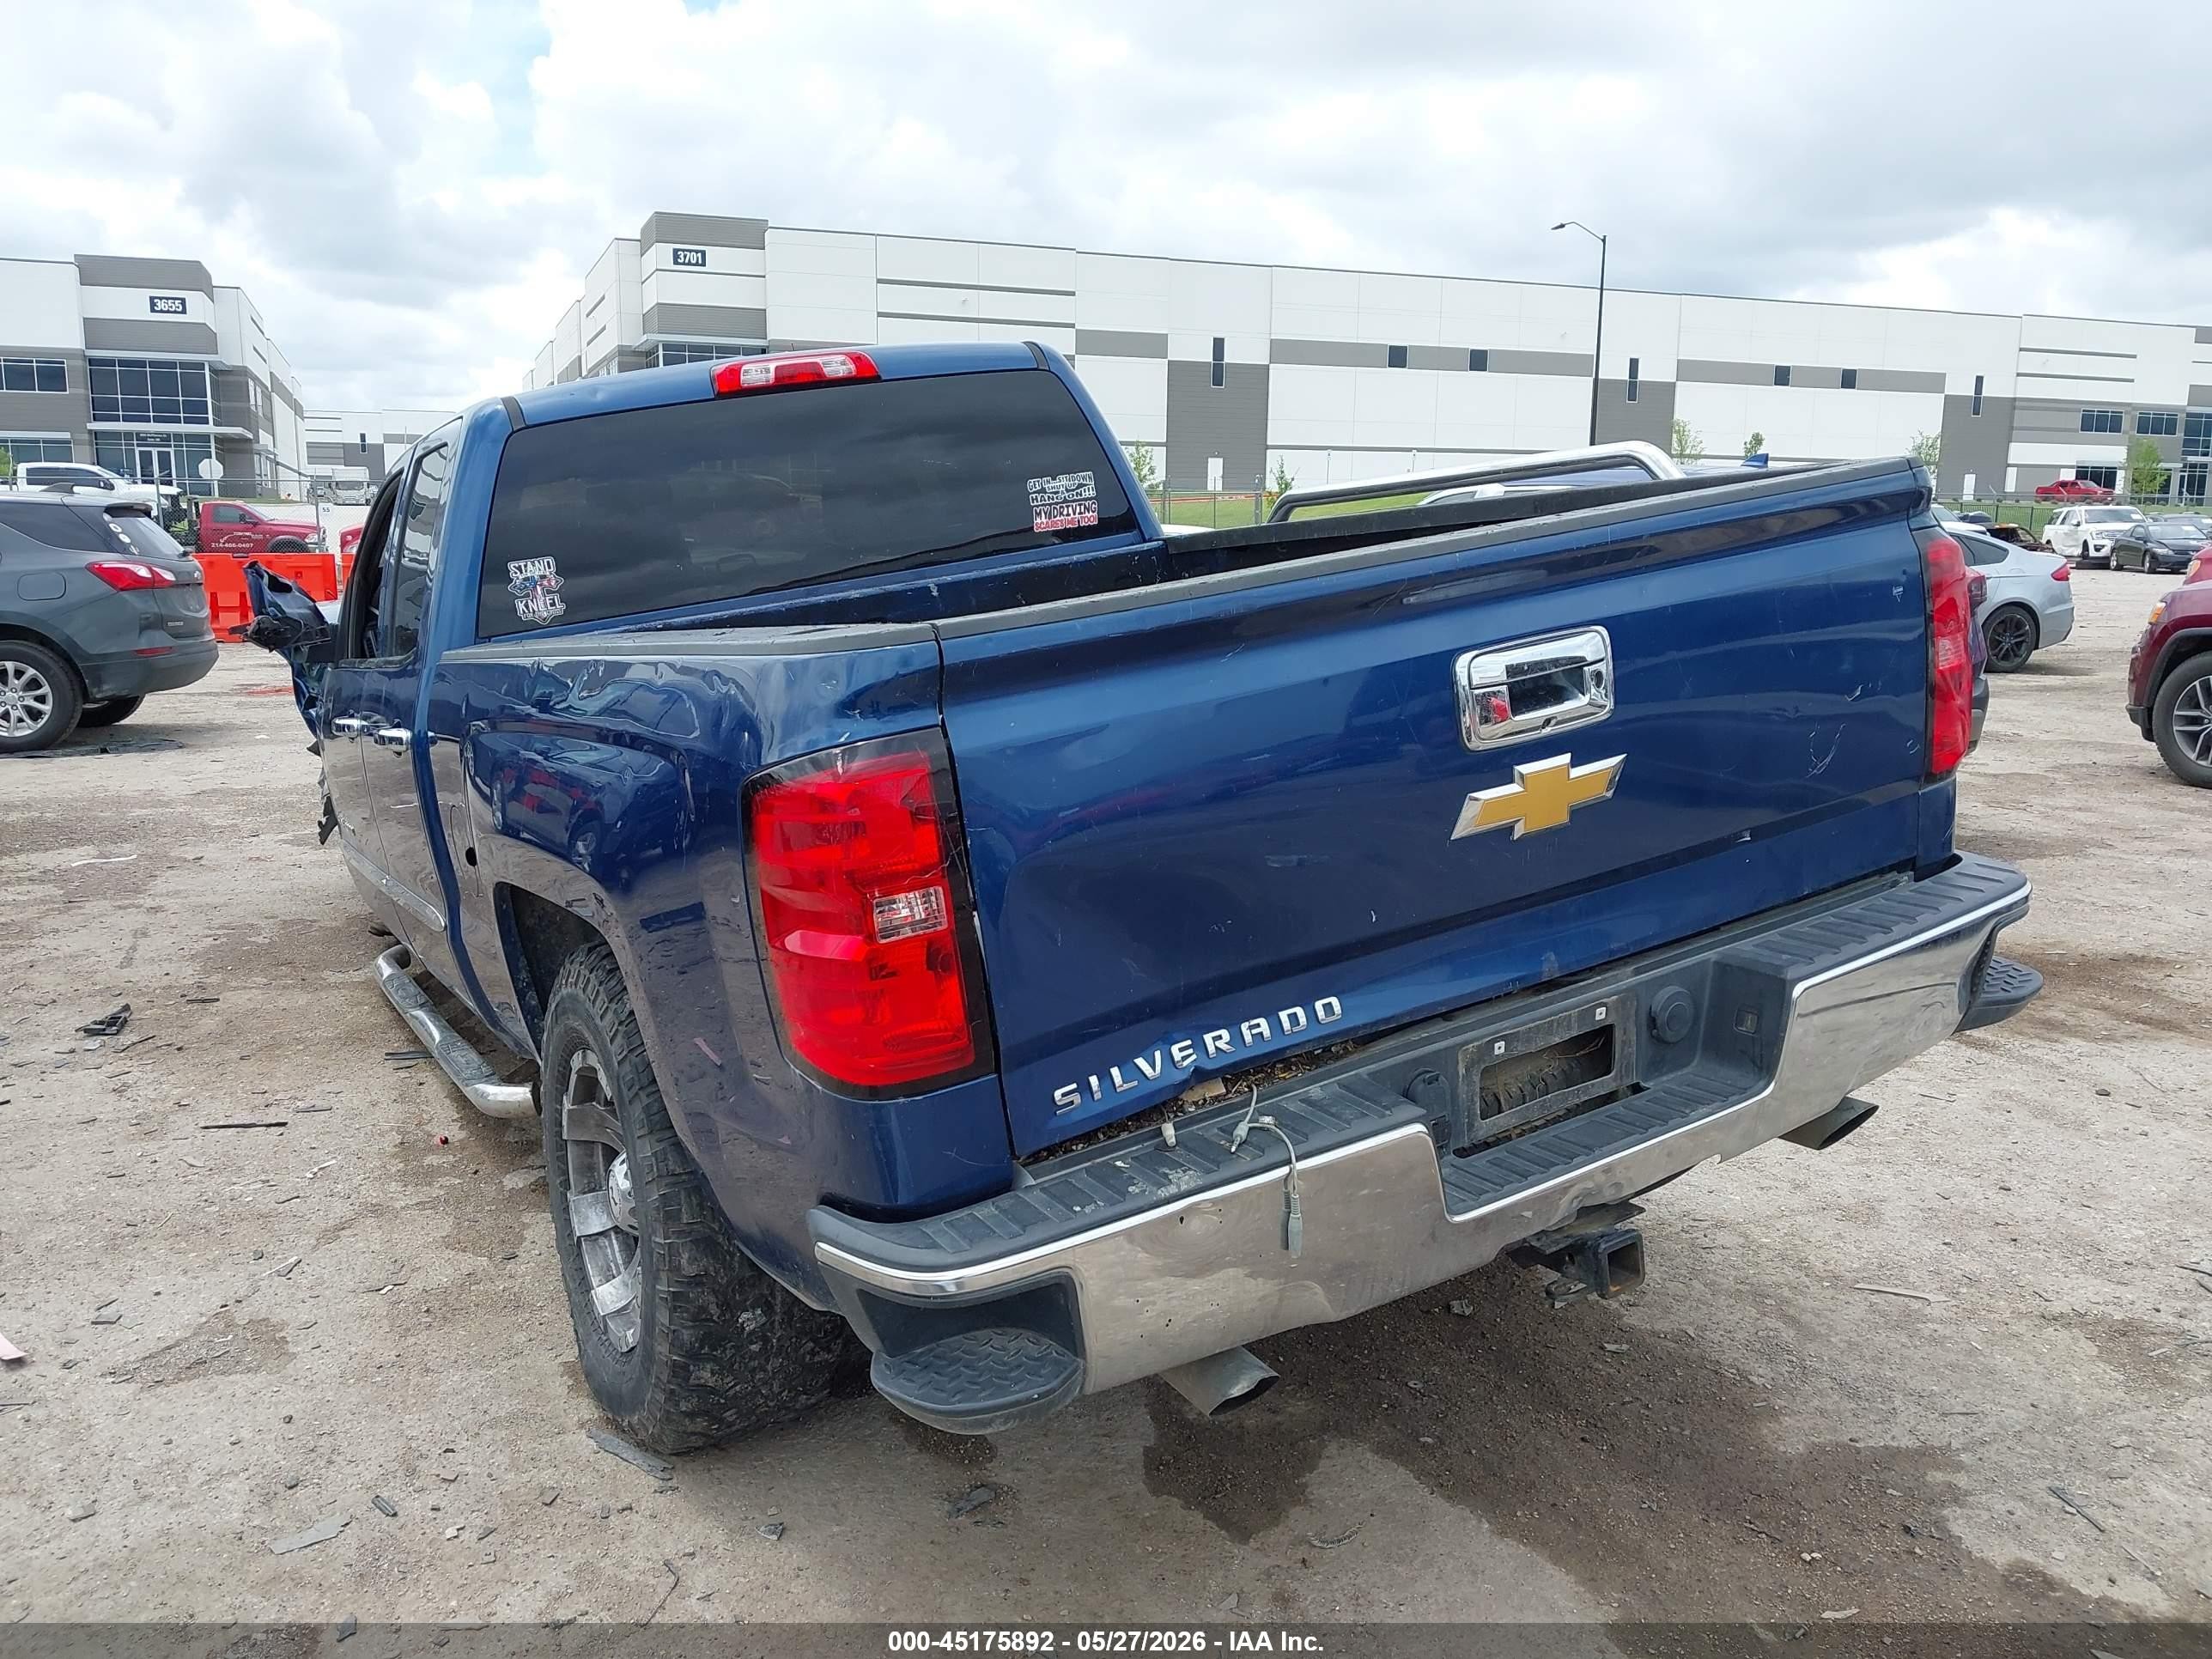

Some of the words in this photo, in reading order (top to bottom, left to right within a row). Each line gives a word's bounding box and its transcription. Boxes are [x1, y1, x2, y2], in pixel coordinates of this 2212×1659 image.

[677, 251, 702, 264] 3701
[154, 299, 183, 312] 3655
[1028, 479, 1041, 491] GET
[1071, 472, 1093, 483] DOWN
[1030, 494, 1064, 505] HANG
[1066, 486, 1096, 499] ON!!!
[1034, 506, 1049, 521] MY
[1052, 501, 1097, 519] DRIVING
[1035, 519, 1065, 531] SCARES
[1066, 516, 1078, 526] ME
[510, 558, 554, 576] STAND
[518, 595, 564, 614] KNEEL
[1053, 995, 1343, 1117] SILVERADO
